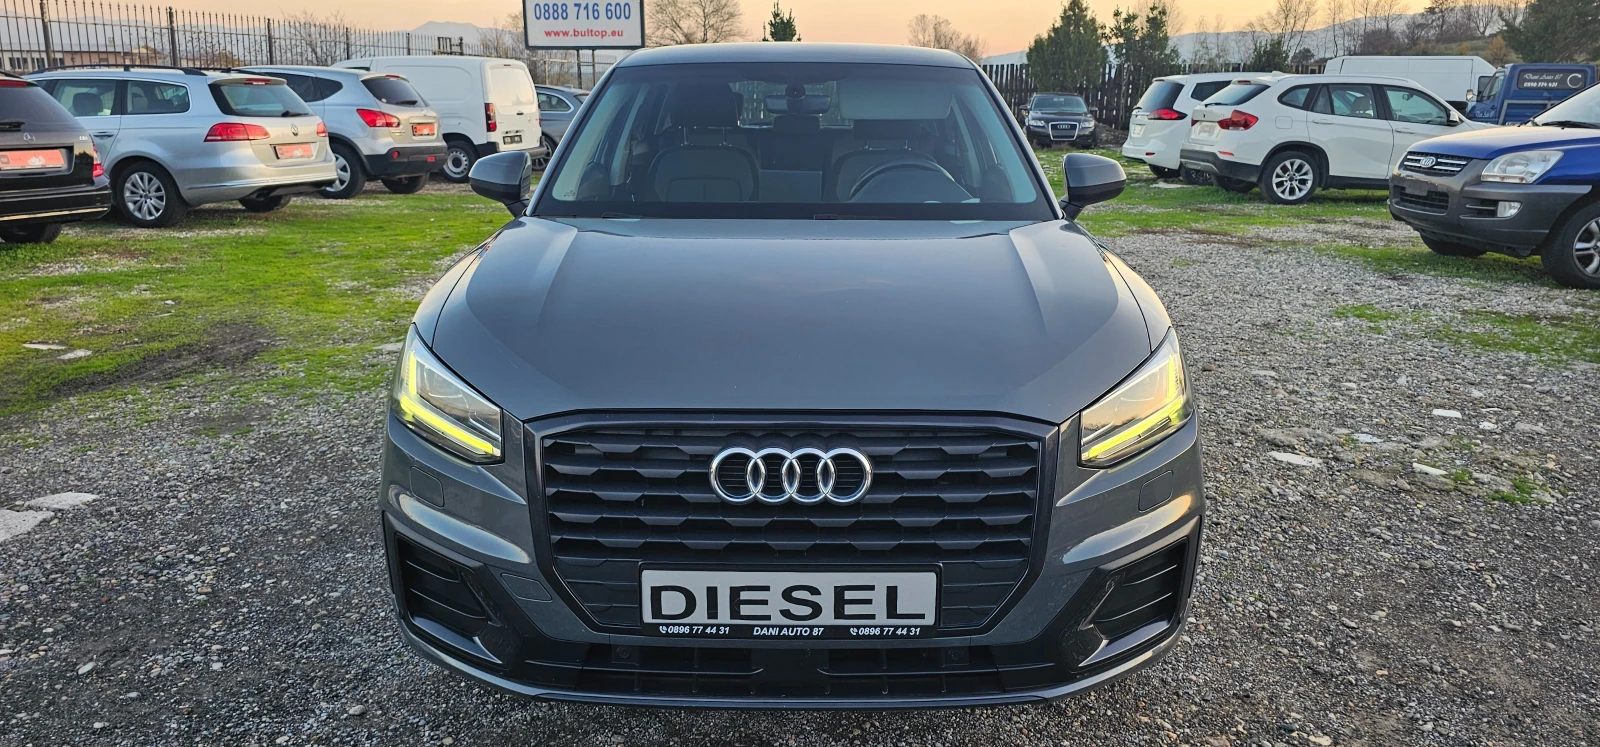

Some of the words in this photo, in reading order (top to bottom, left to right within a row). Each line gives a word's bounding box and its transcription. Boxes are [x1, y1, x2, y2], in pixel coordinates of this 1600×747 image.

[534, 3, 569, 20] 0888
[574, 3, 600, 20] 716
[606, 3, 631, 20] 600
[544, 28, 624, 39] www.bultop.eu
[650, 585, 926, 621] DIESEL
[667, 625, 690, 634] 0896
[692, 626, 703, 634] 77
[705, 626, 716, 634] 44
[718, 626, 730, 634] 31
[753, 627, 779, 636] DANI
[780, 627, 810, 636] AUTO
[812, 627, 824, 636] 87
[858, 627, 881, 636] 0896
[883, 627, 894, 636] 77
[896, 627, 907, 636] 44
[909, 627, 920, 636] 31
